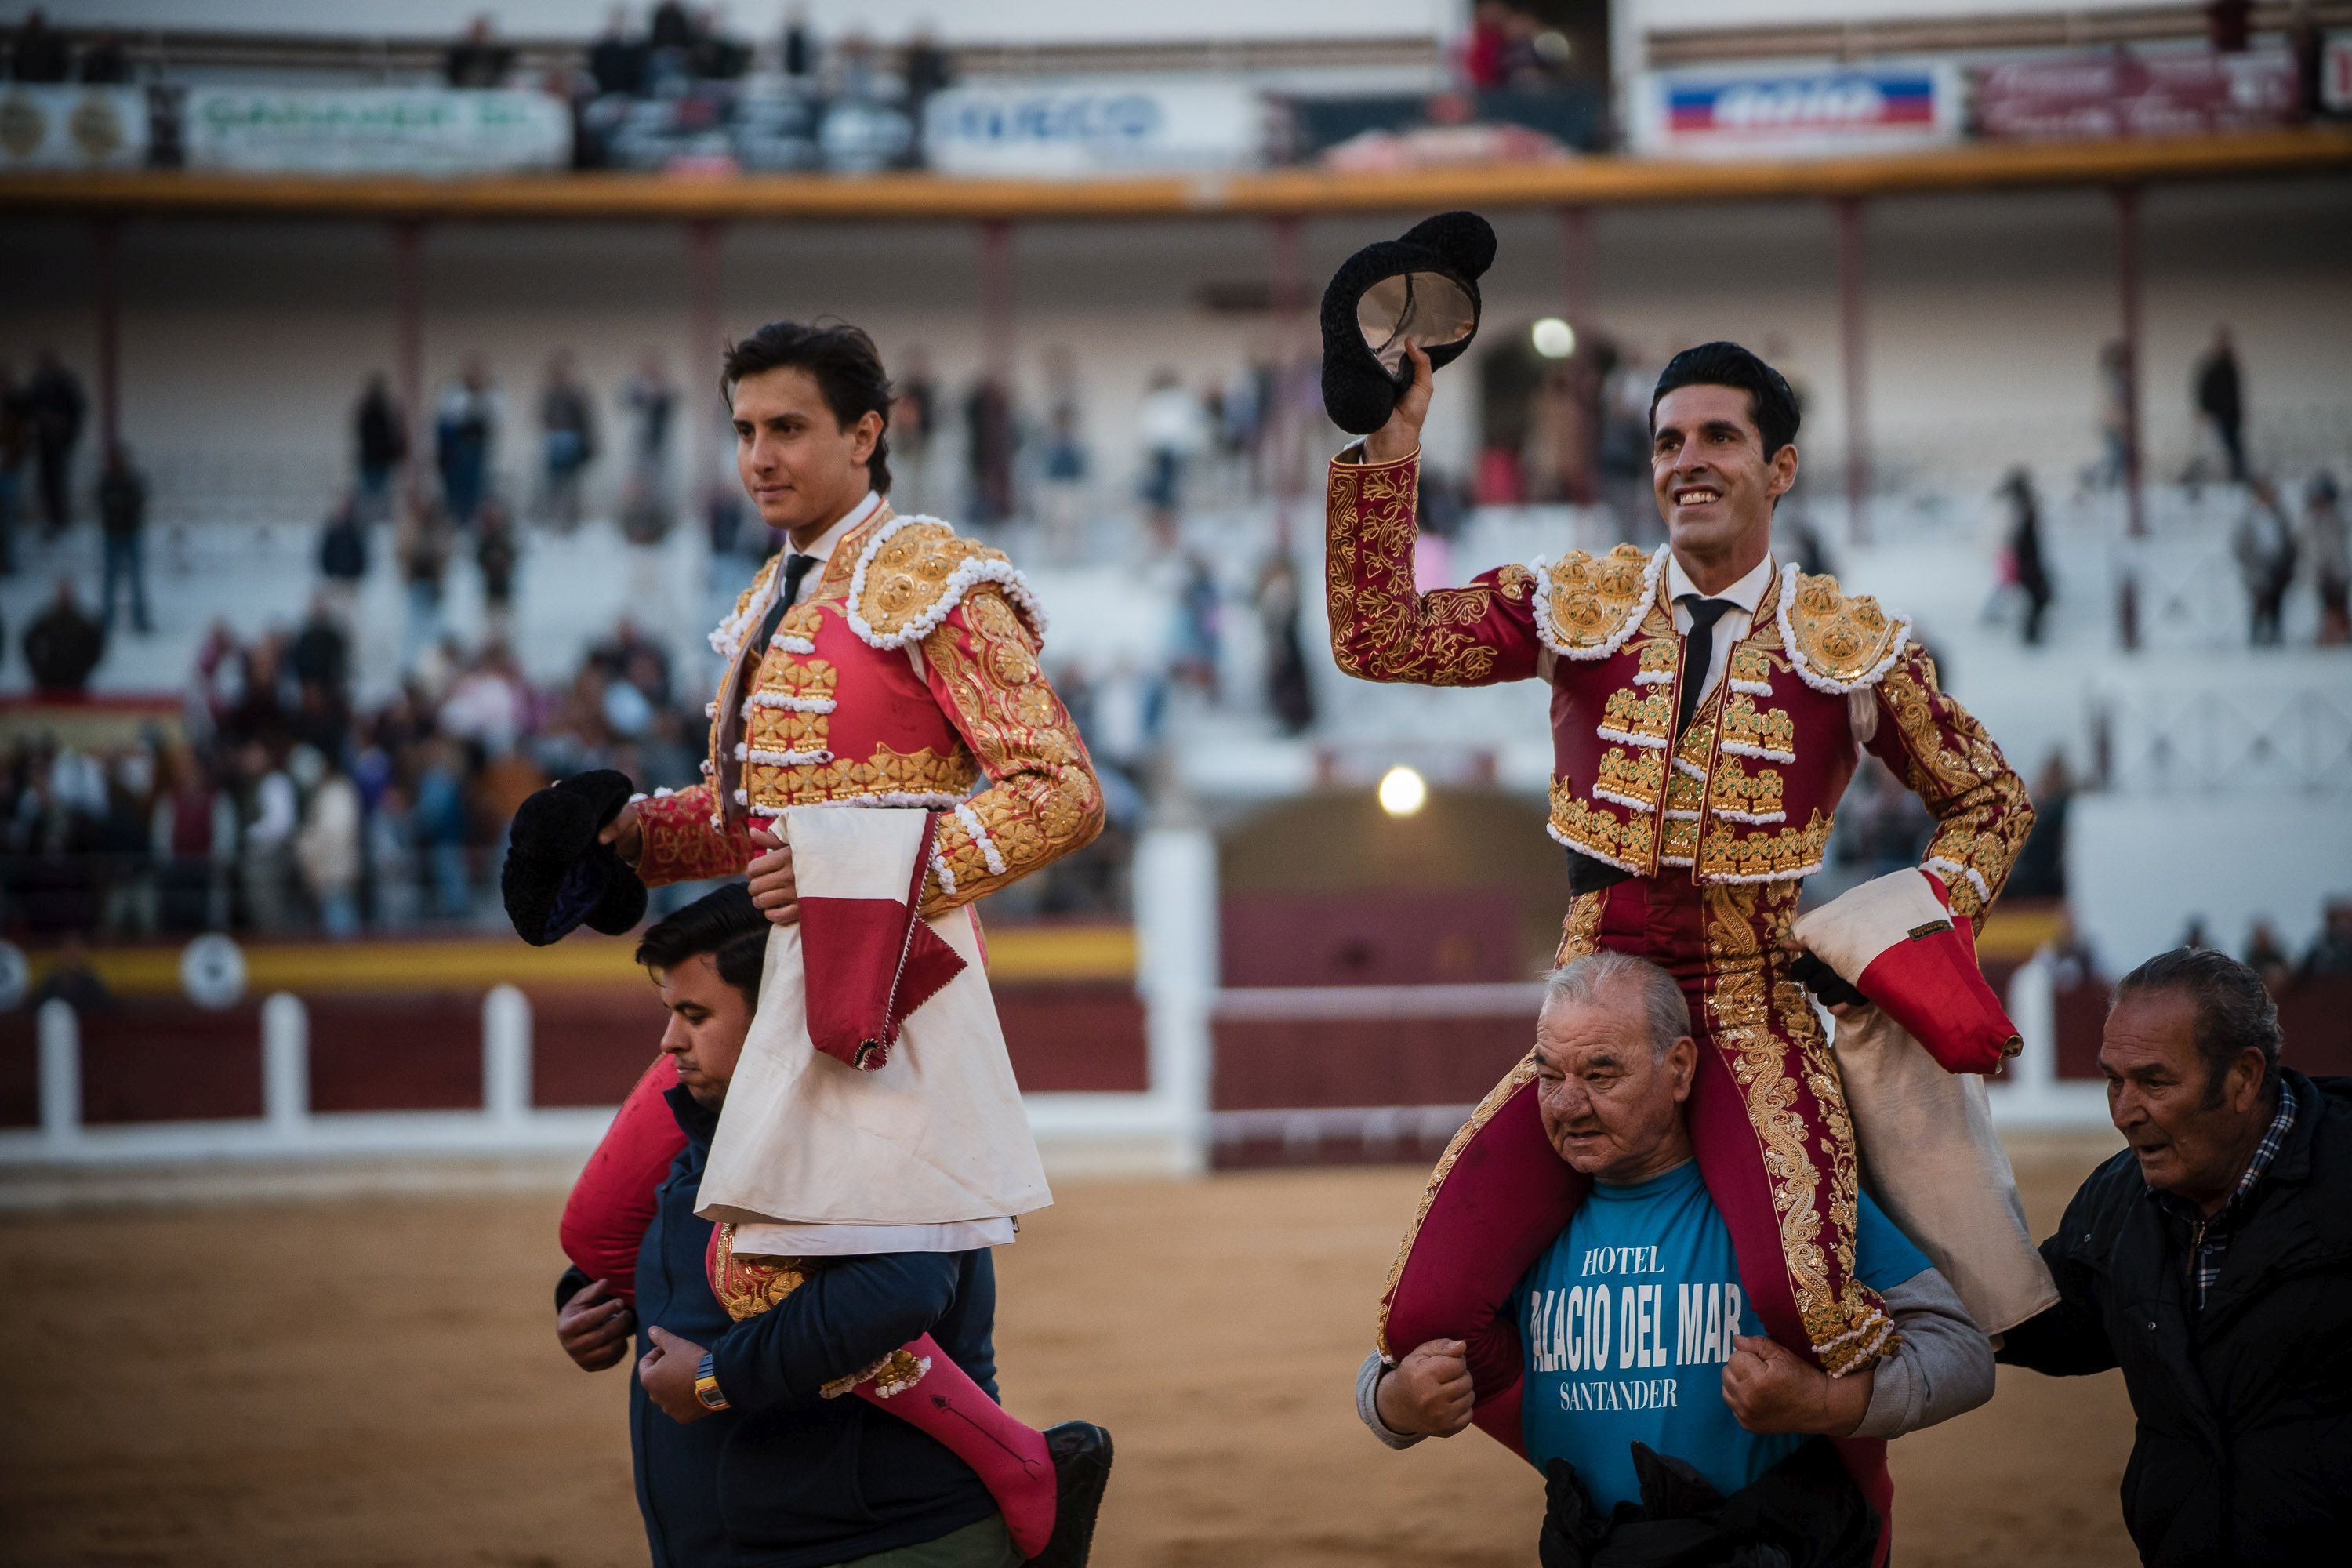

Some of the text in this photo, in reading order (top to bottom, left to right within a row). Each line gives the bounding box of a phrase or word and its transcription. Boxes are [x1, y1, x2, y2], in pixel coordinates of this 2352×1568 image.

[1581, 1245, 1665, 1276] HOTEL
[1619, 1284, 1668, 1370] DEL
[1676, 1283, 1741, 1366] MAR
[1559, 1378, 1677, 1411] SANTANDER
